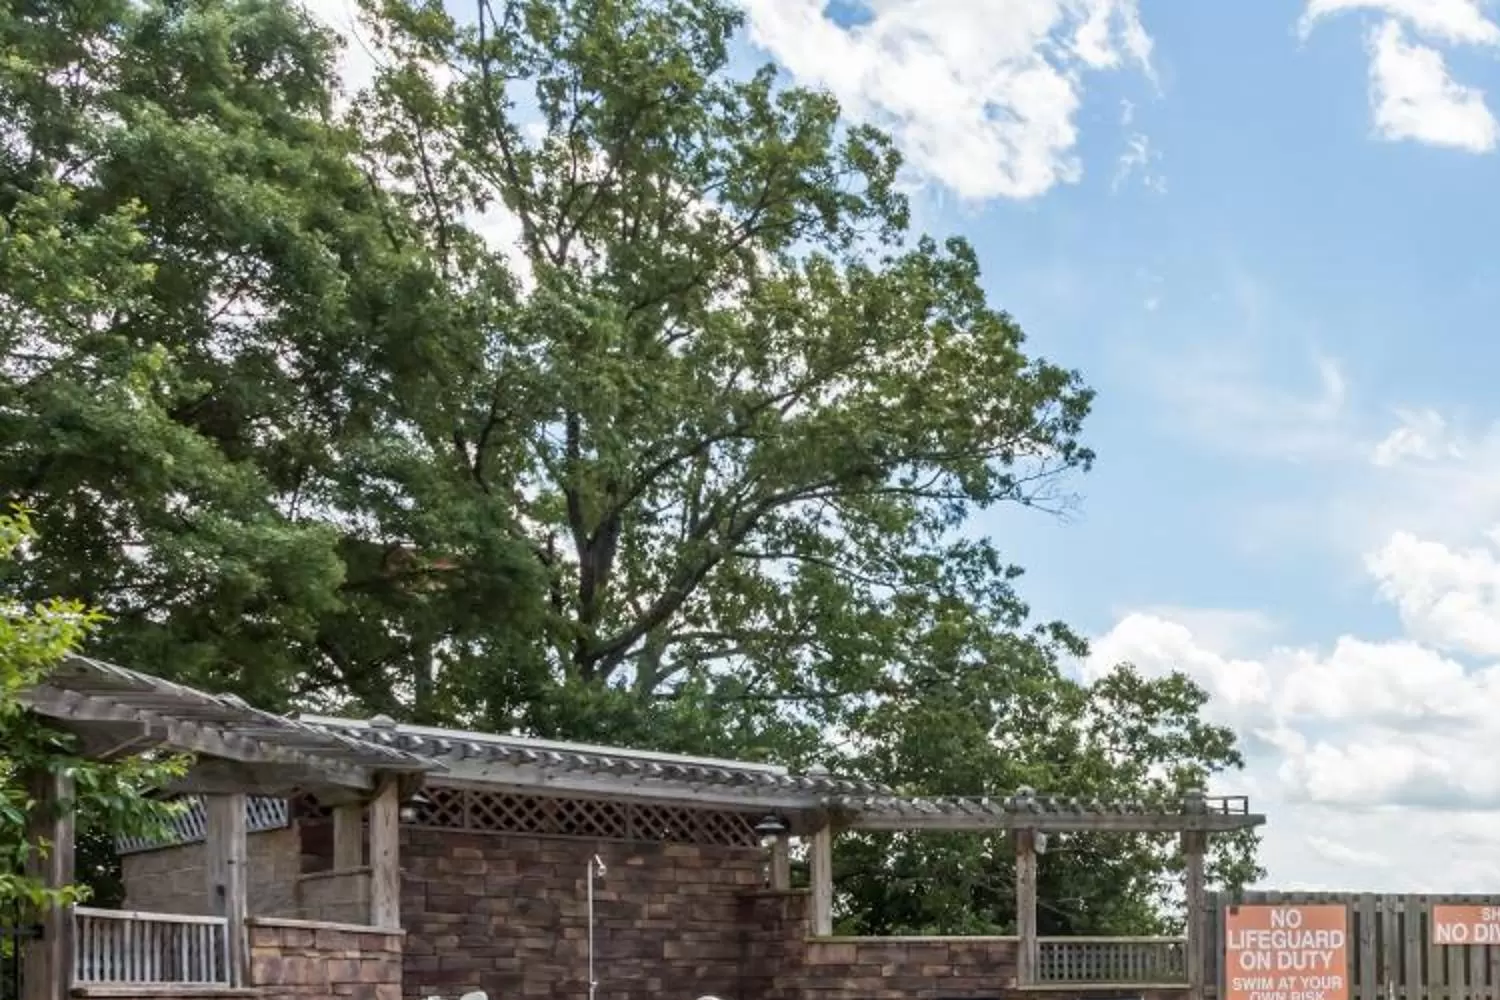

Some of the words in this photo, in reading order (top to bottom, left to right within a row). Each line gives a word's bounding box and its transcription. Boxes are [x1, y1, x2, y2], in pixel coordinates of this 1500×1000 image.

[1270, 908, 1302, 928] NO
[1228, 929, 1345, 949] LIFEGUARD
[1436, 923, 1470, 943] NO
[1239, 950, 1272, 971] ON
[1277, 950, 1335, 971] DUTY
[1231, 977, 1275, 991] SWIM
[1277, 976, 1297, 990] AT
[1299, 975, 1343, 990] YOUR
